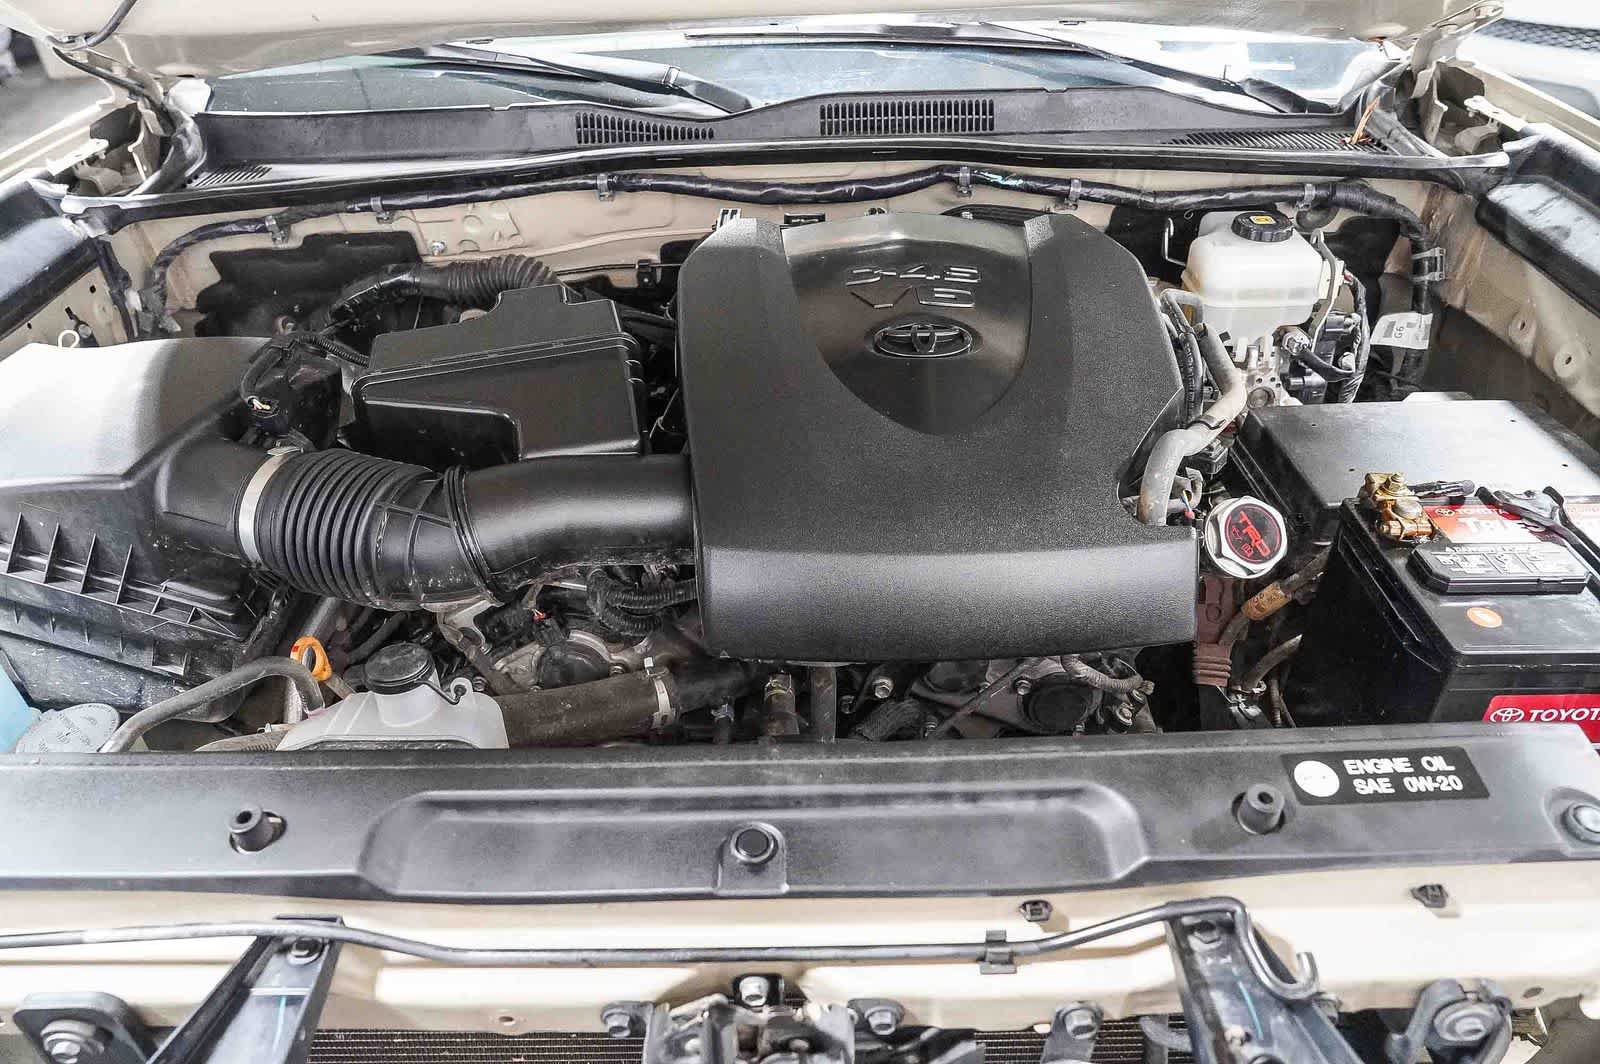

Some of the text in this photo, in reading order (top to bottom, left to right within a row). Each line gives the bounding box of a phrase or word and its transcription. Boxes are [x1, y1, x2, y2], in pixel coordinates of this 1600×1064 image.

[1238, 510, 1271, 557] TRD
[1529, 708, 1600, 721] TOYOT
[1343, 756, 1455, 775] ENGINE OIL
[1353, 775, 1463, 795] SAE 0W-20
